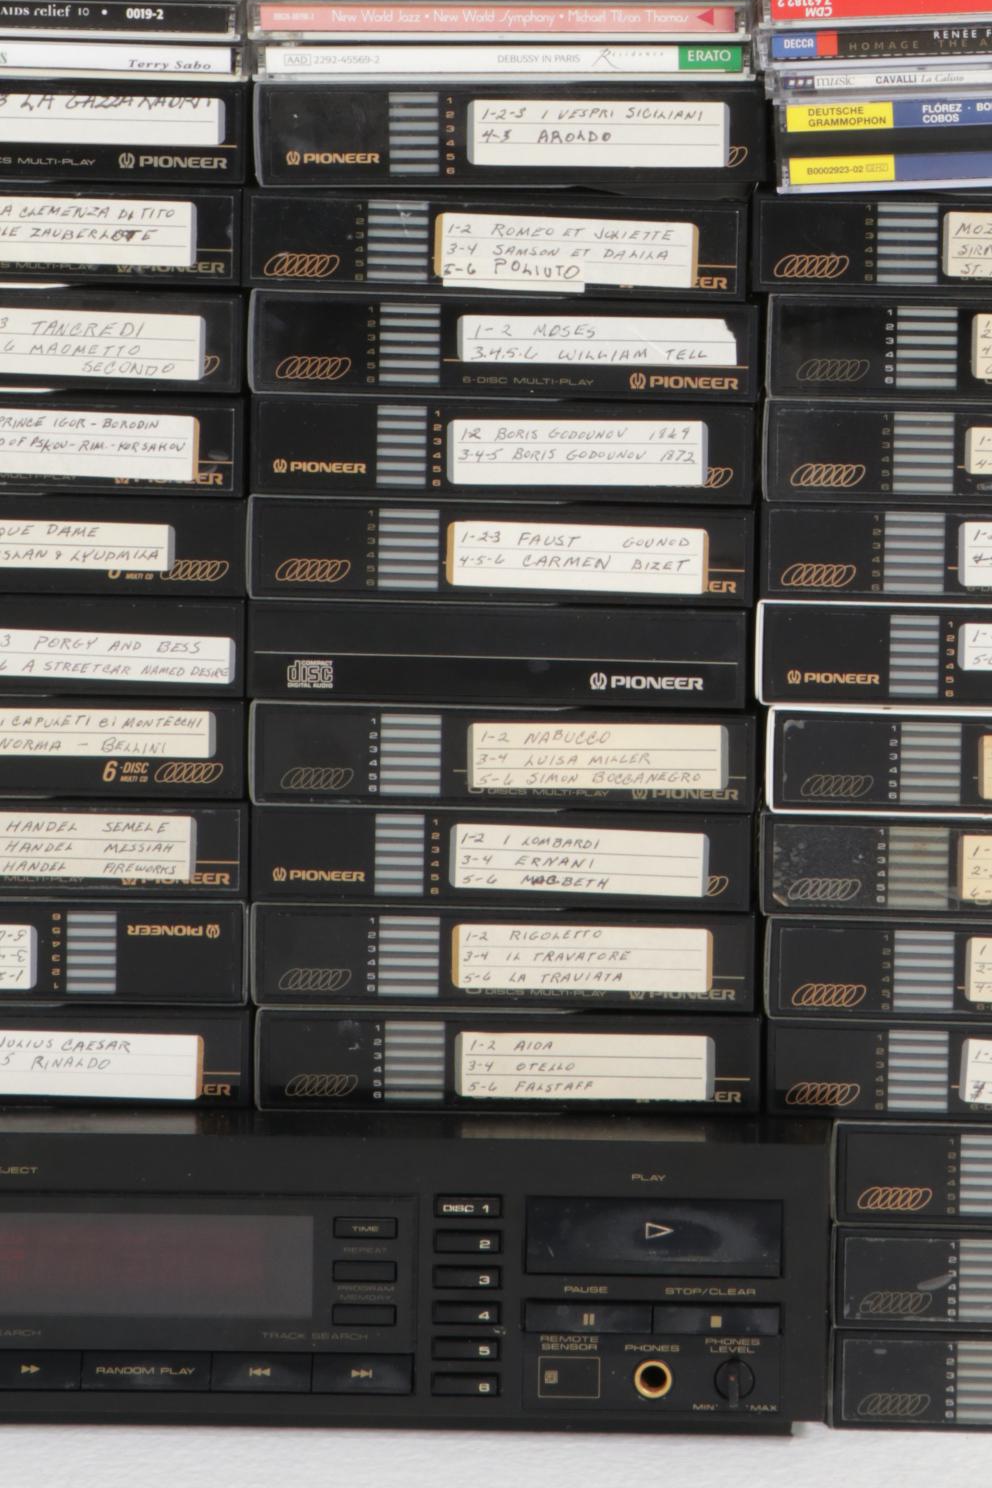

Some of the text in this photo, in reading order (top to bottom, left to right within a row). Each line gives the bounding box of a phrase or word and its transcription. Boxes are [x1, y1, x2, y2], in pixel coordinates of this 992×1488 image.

[126, 8, 164, 20] 0019-2
[807, 115, 888, 127] GRAMMOPHON
[303, 153, 380, 165] PIONEER
[649, 375, 739, 390] PIONEER
[611, 676, 703, 691] PIONEER
[128, 925, 203, 936] PIONEER
[632, 1174, 666, 1182] PLAY
[443, 1204, 474, 1213] DISC
[564, 1286, 608, 1294] PAUSE
[665, 1287, 756, 1297] STOP/CLEAR
[624, 1344, 679, 1352] PHONES
[96, 1366, 195, 1376] RANDOM PLAY
